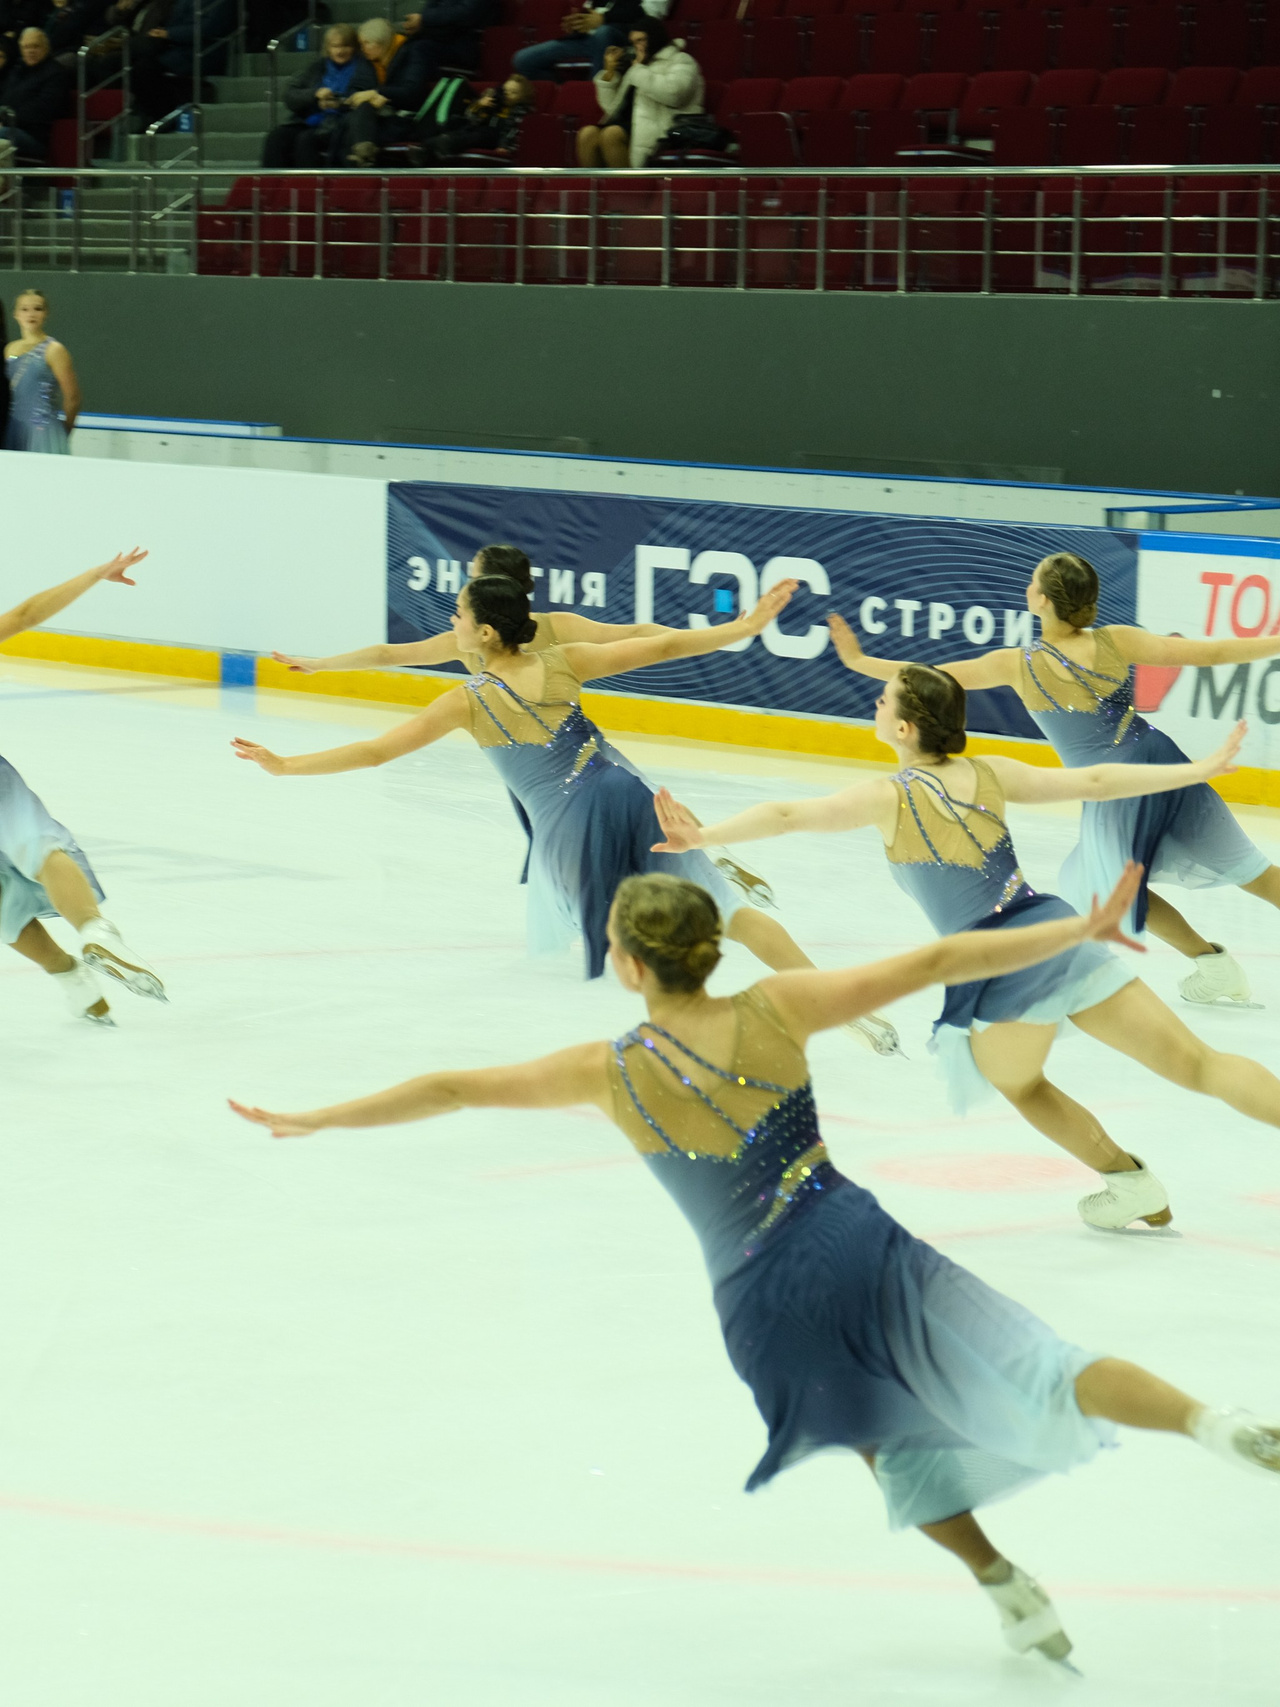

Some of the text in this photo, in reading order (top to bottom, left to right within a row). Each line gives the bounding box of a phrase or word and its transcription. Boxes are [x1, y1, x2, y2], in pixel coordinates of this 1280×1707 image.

[635, 544, 831, 660] ГЭС
[859, 596, 1034, 648] СТРОИ
[1200, 571, 1280, 640] ТО
